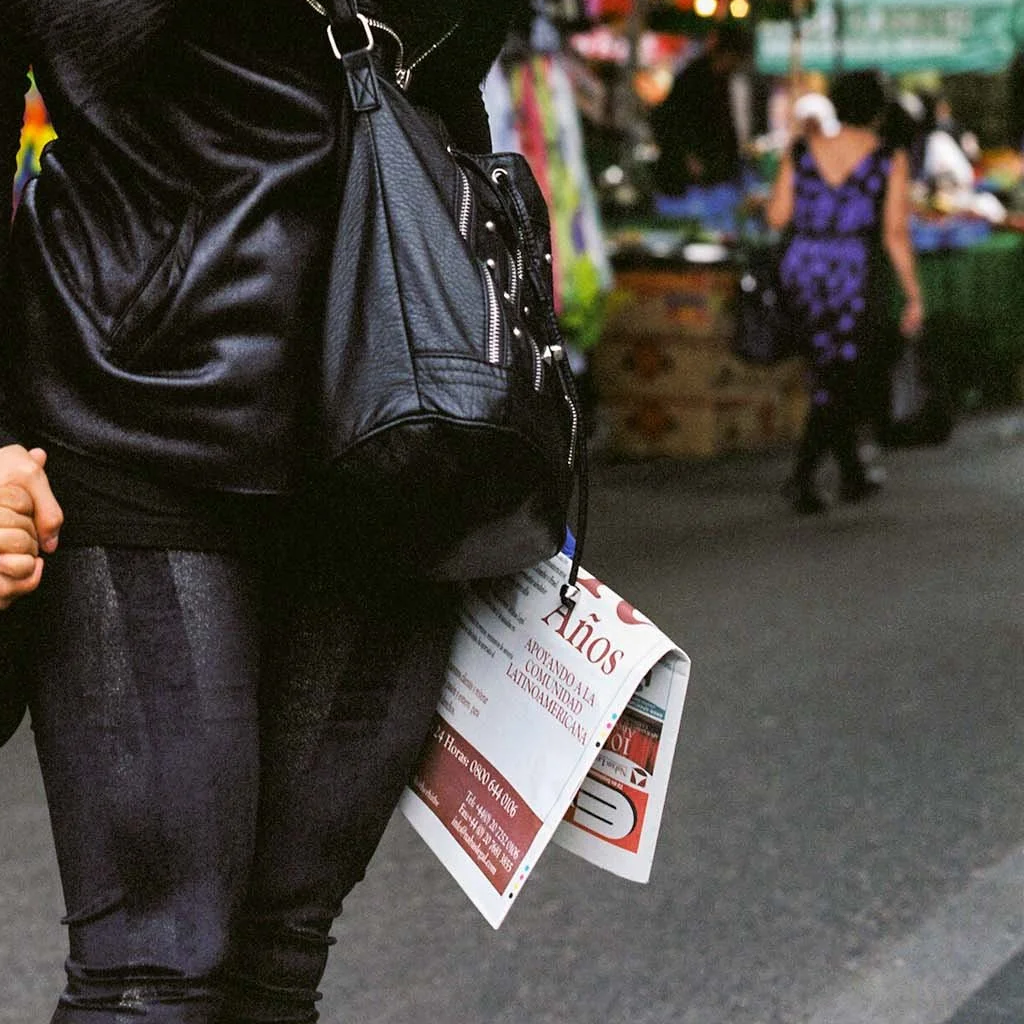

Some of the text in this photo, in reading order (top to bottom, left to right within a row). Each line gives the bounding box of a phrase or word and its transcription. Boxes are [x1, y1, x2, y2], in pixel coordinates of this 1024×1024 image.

[524, 638, 596, 707] APOYANDO A LA
[541, 603, 624, 675] Años
[505, 662, 588, 746] LATINOAMERICANA
[525, 659, 583, 715] COMUNIDAD
[443, 732, 470, 767] Horas:
[469, 759, 490, 785] 0800
[487, 780, 503, 801] 644
[500, 793, 519, 818] 0106
